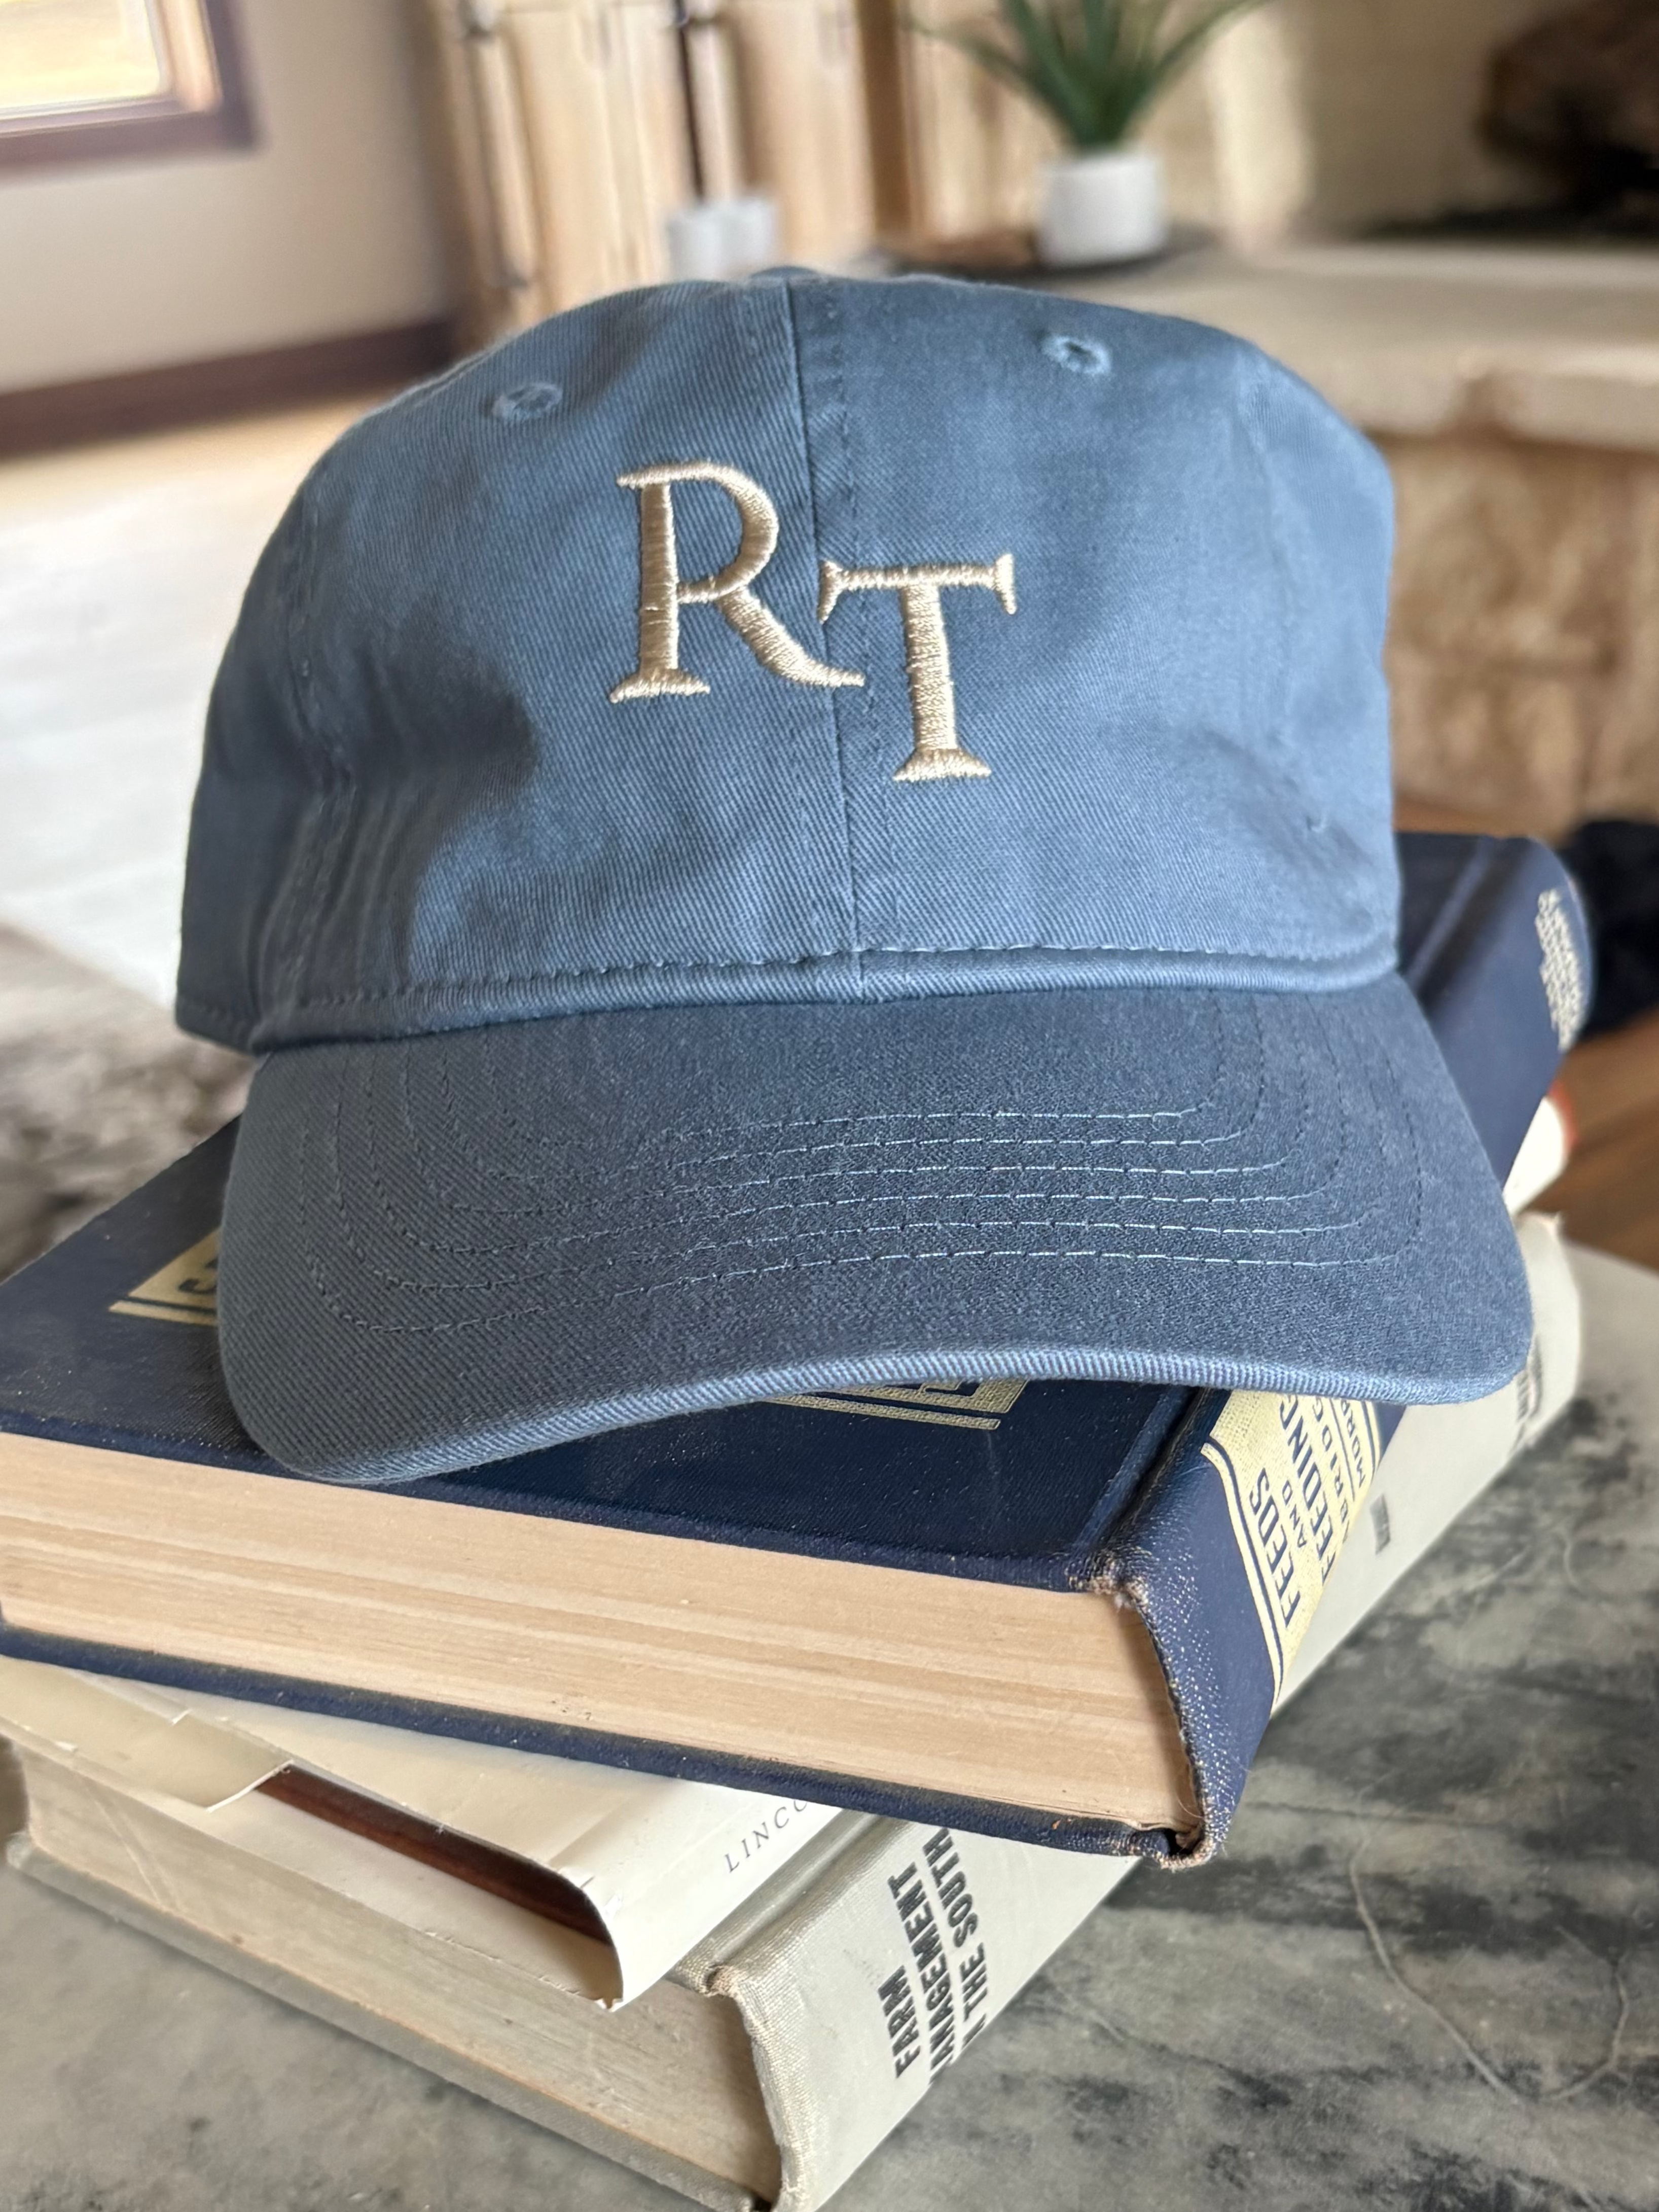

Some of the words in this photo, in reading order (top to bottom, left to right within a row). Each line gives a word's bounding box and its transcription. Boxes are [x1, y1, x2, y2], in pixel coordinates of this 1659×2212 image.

[1249, 1467, 1301, 1628] FEEDS
[1279, 1395, 1336, 1586] FEEDING
[1282, 1479, 1307, 1548] AND
[922, 1828, 978, 1947] SOUTH
[878, 1965, 921, 2078] FARM
[888, 1862, 955, 2085] ANAGEMENT
[959, 1942, 988, 2022] THE
